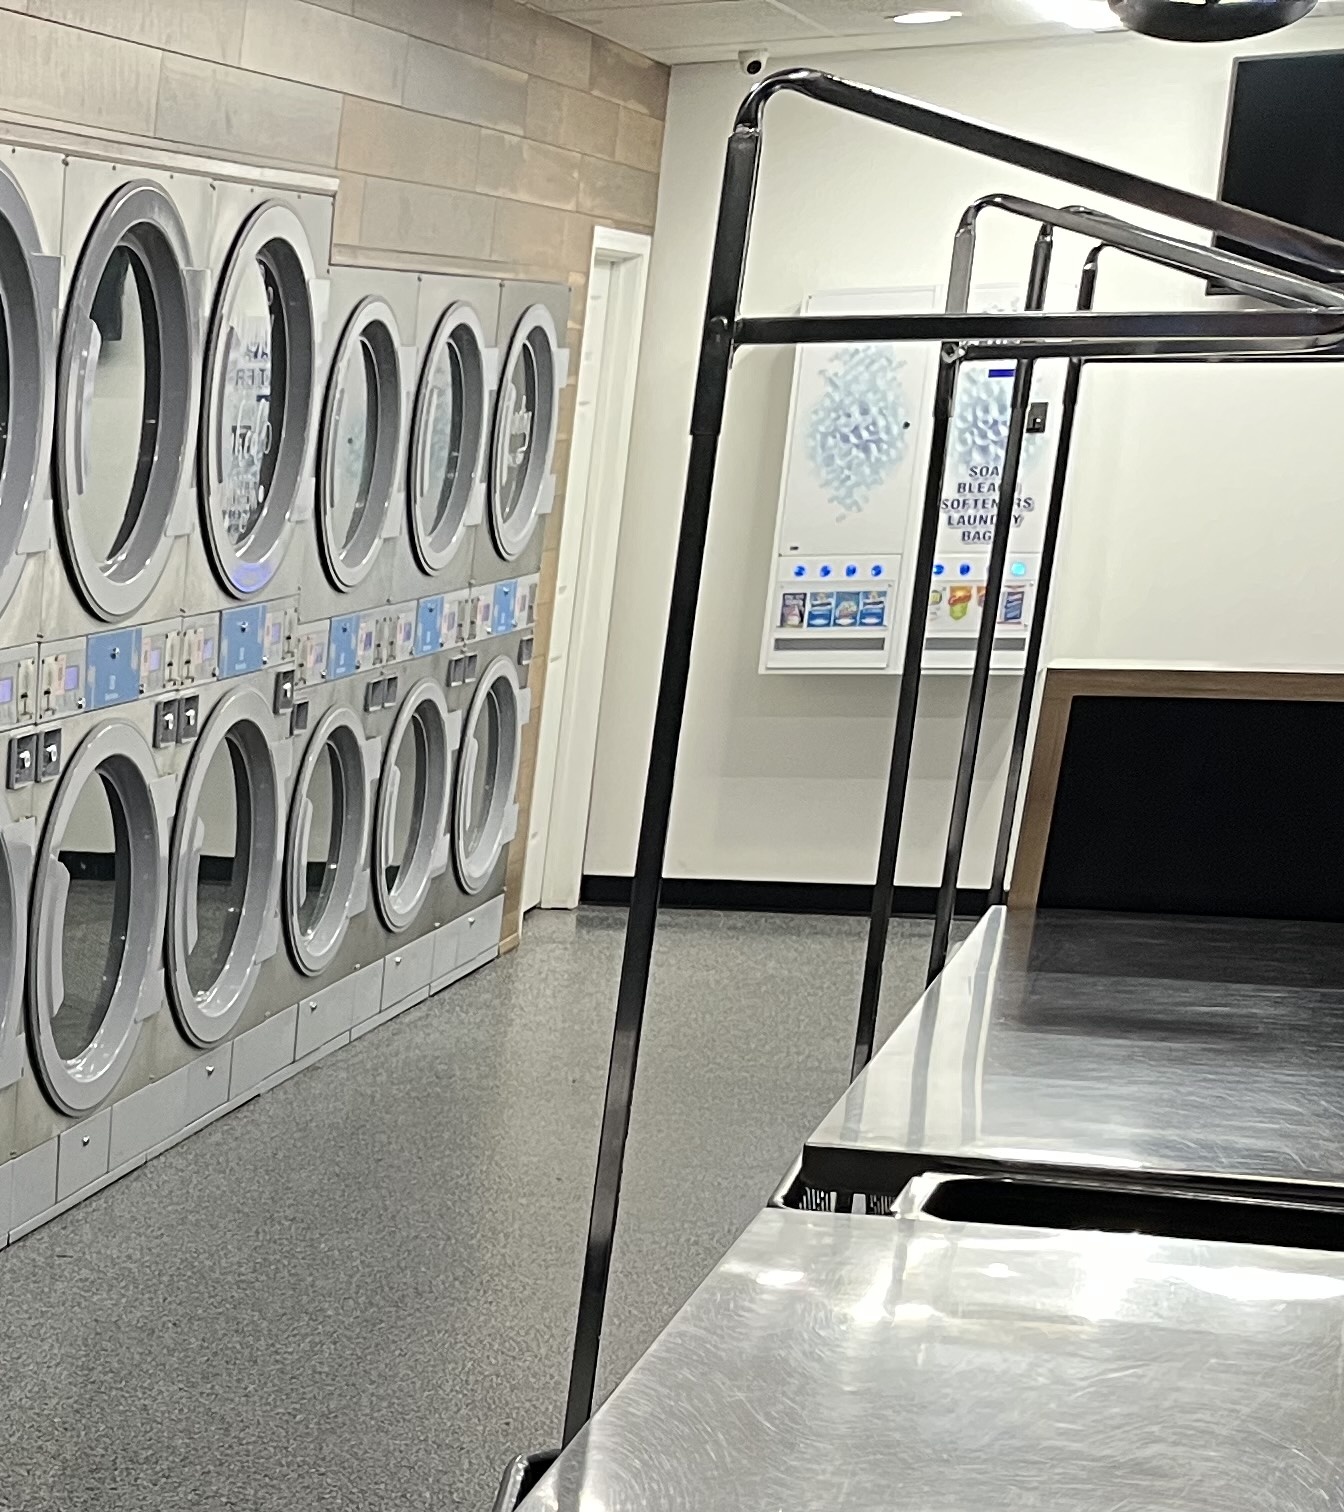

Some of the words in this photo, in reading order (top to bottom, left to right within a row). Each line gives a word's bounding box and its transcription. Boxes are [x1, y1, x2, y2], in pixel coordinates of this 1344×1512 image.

[968, 465, 1000, 478] SOA
[957, 482, 1021, 494] BLEA
[941, 497, 1033, 510] SOFTENRS
[947, 514, 1021, 526] LAUNY
[961, 530, 993, 542] BAG
